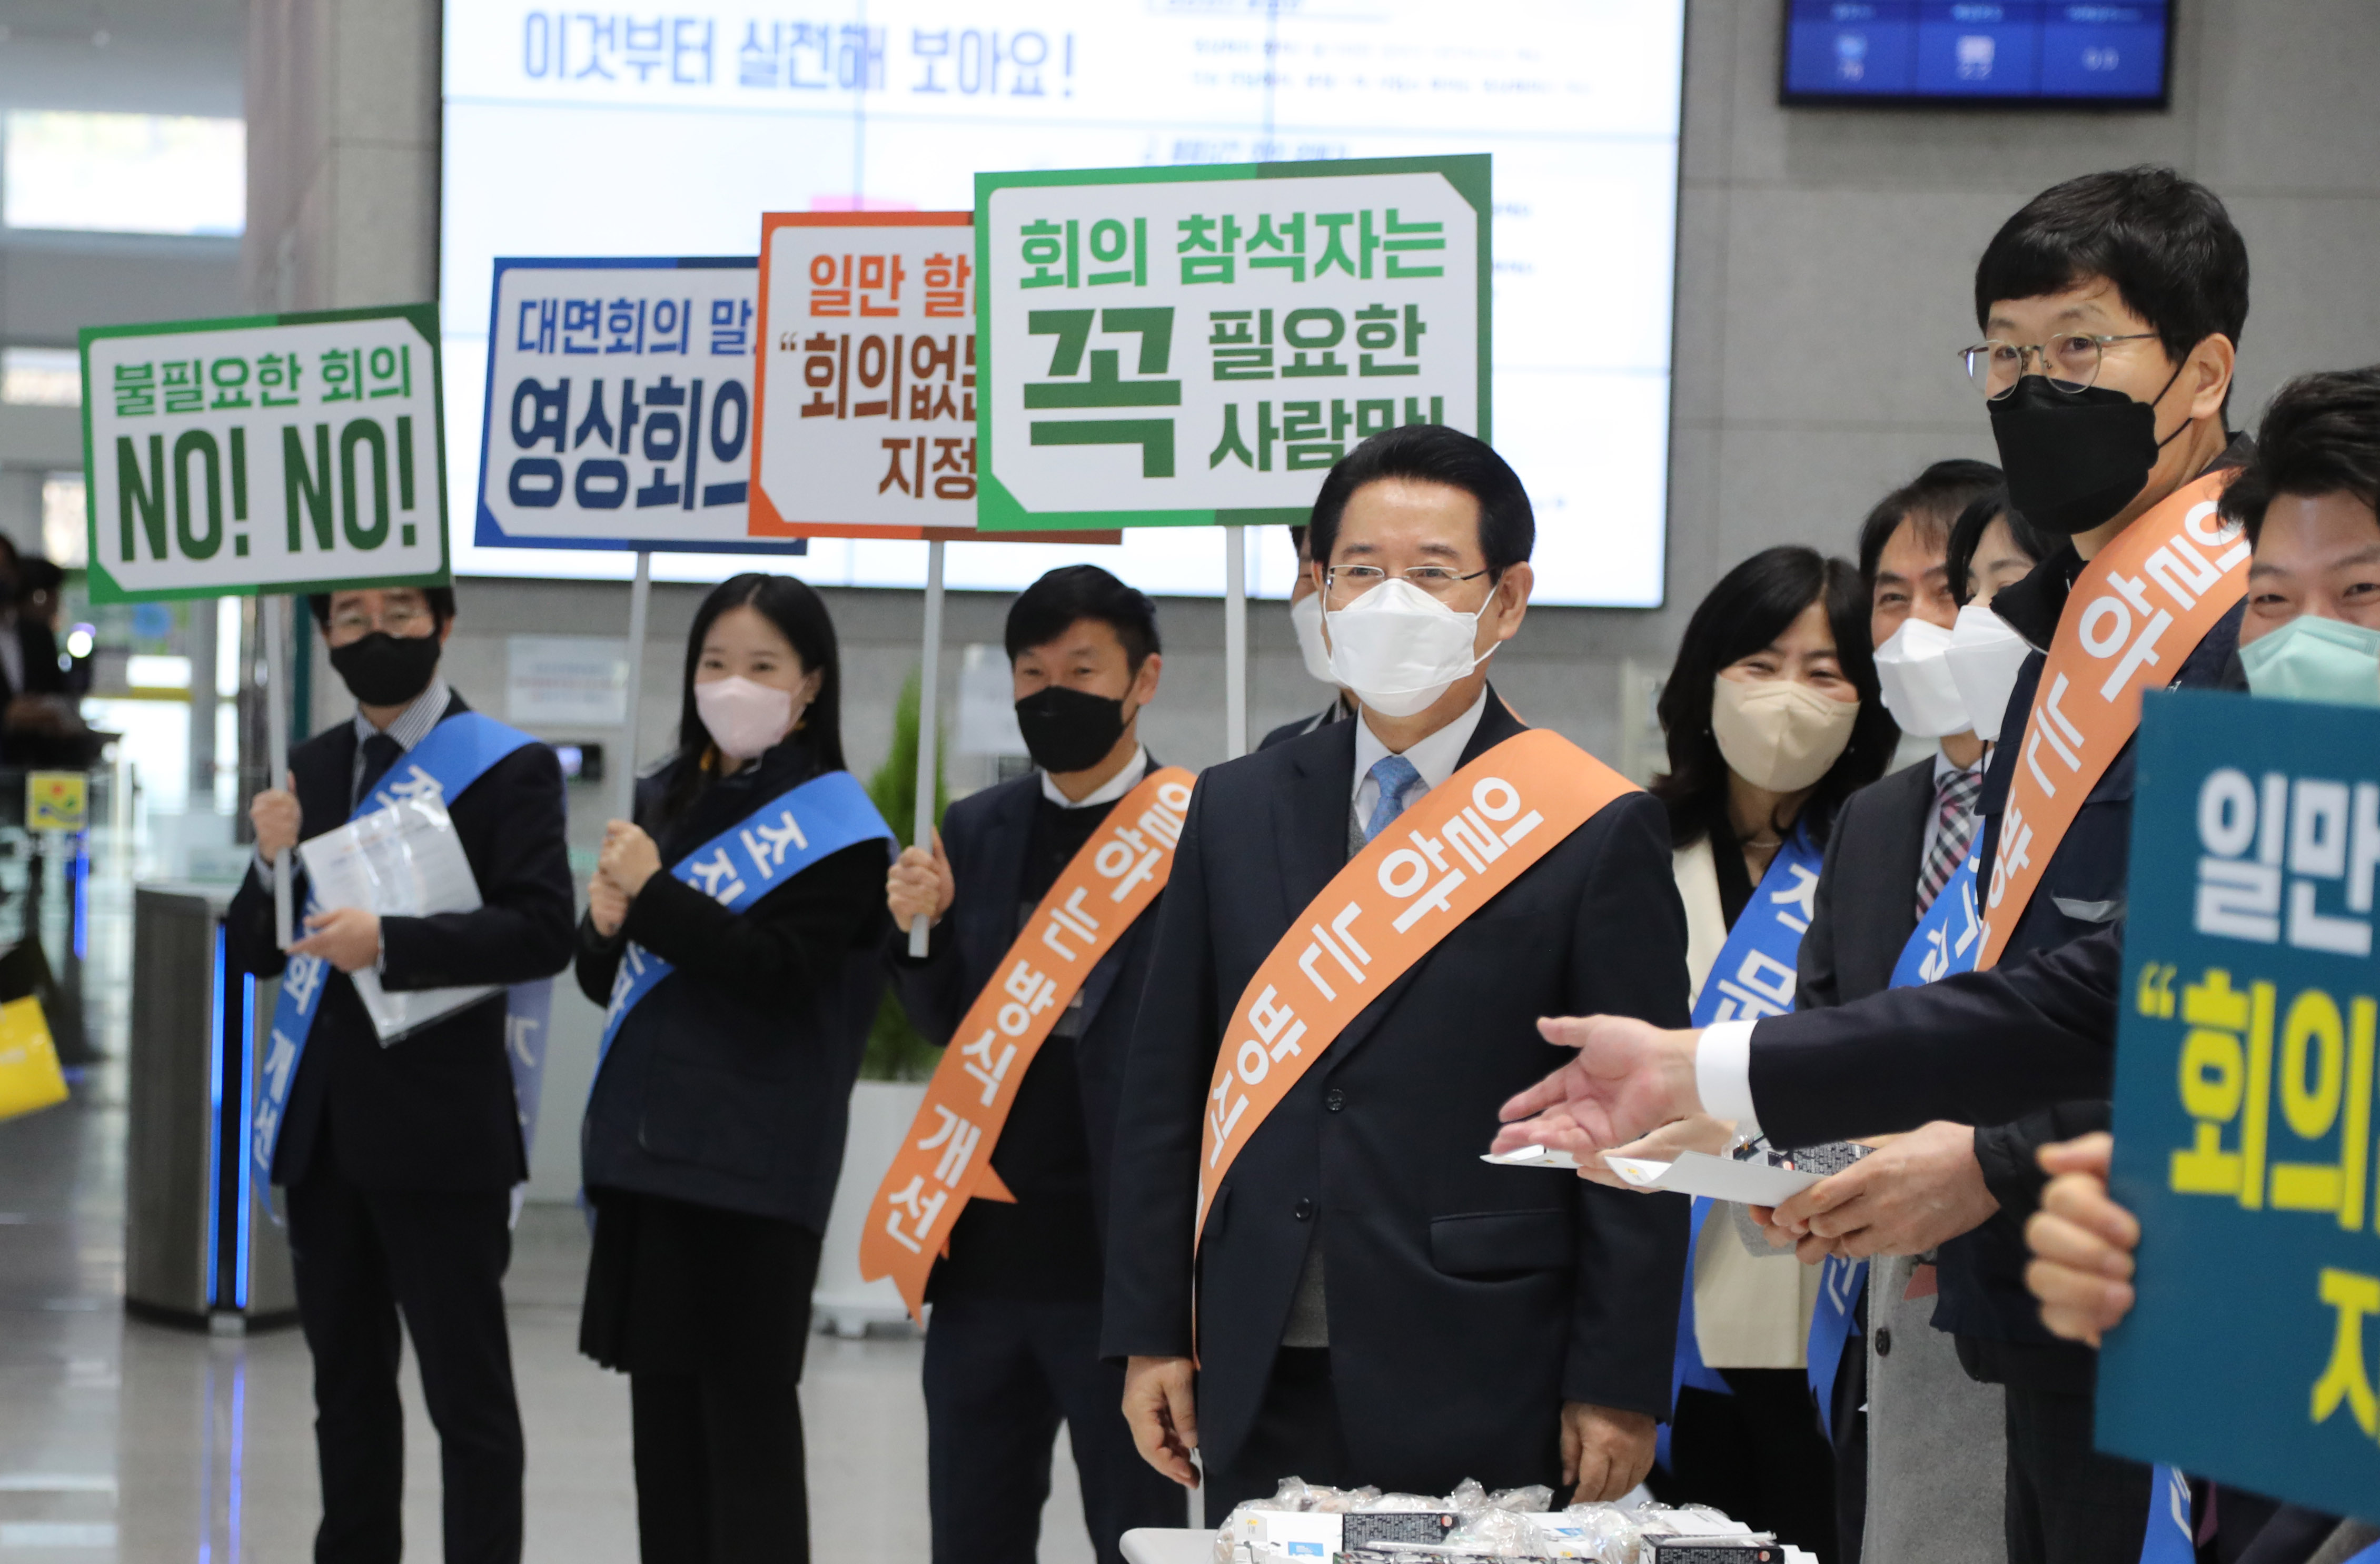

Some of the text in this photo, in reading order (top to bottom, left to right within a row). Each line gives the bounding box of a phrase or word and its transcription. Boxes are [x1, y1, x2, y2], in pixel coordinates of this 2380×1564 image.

[523, 11, 1074, 98] 이것부터 실천해 보아요!
[809, 252, 976, 318] 일만 할
[1020, 209, 1446, 289] 회의 참석자는
[114, 343, 411, 417] 불필요한 회의
[516, 297, 757, 355] 대면회의 말
[1024, 306, 1182, 478] 꼭
[1208, 303, 1426, 381] 필요한
[115, 415, 416, 562] NO! NO!
[2026, 499, 2253, 798] 일하는
[1298, 777, 1544, 1002] 일하는
[2194, 766, 2380, 959] 일만
[886, 781, 1193, 1254] 일하는 방식 개선
[2136, 962, 2380, 1239] “회의
